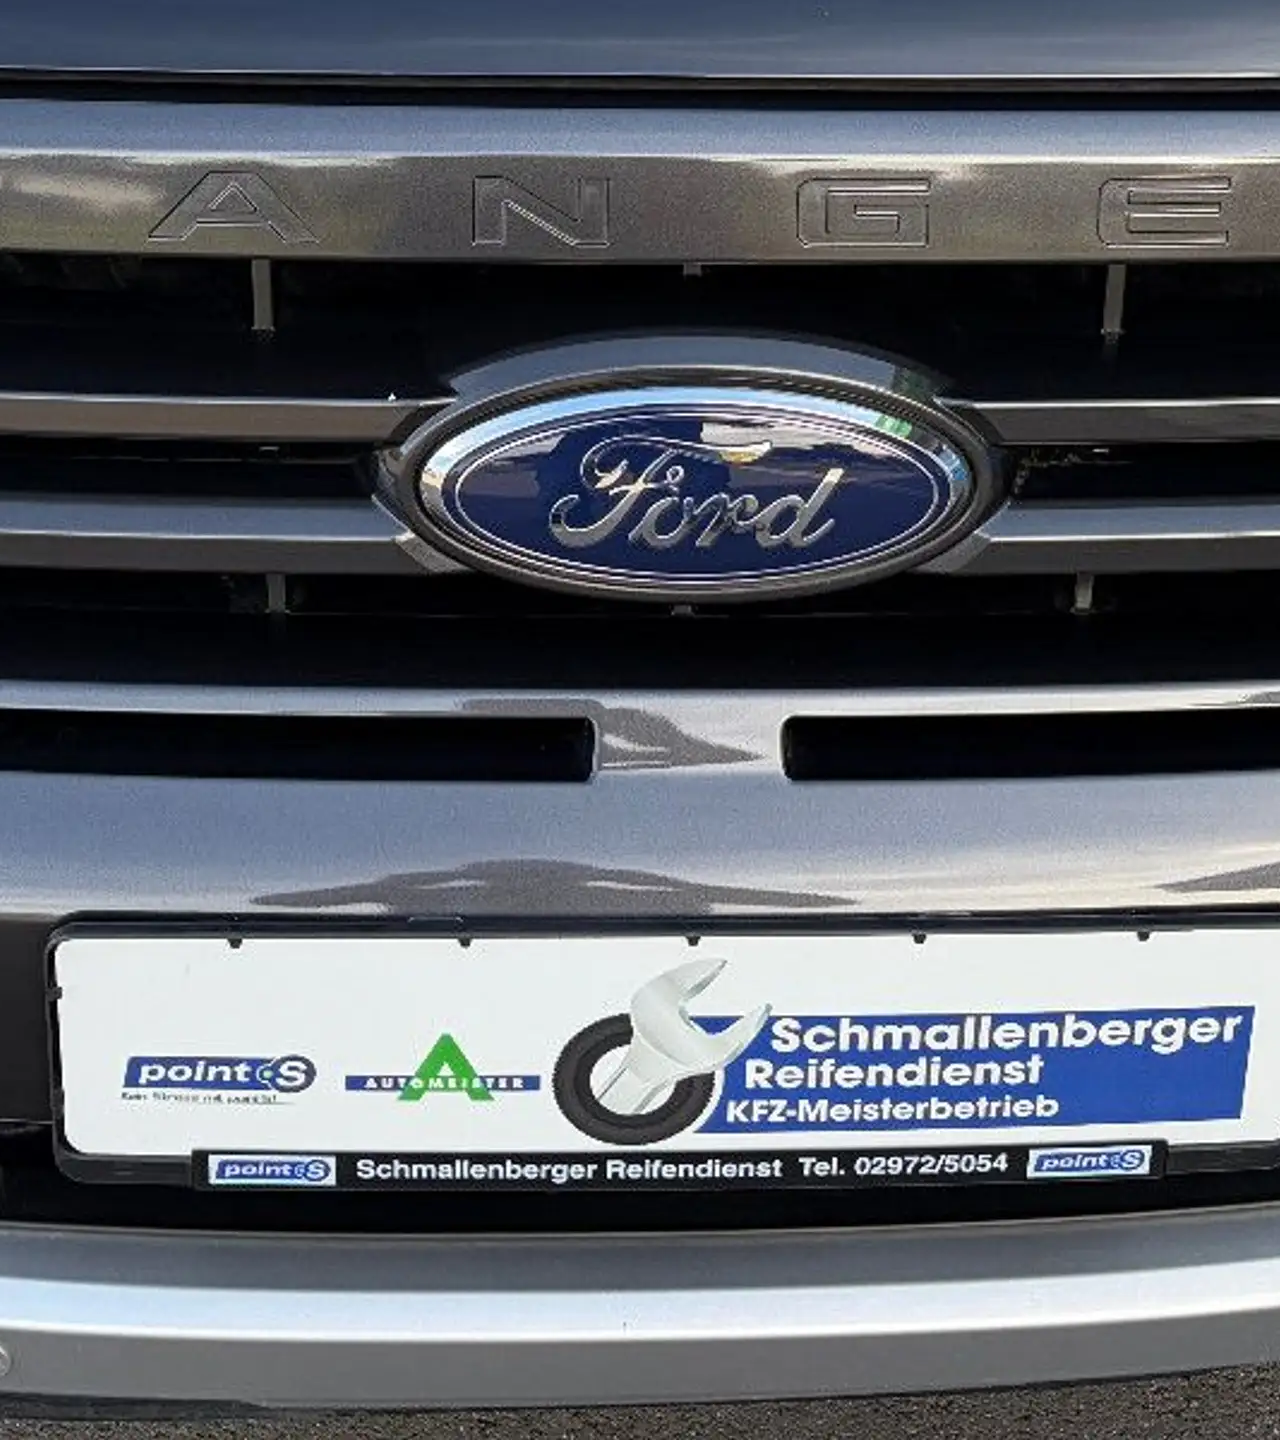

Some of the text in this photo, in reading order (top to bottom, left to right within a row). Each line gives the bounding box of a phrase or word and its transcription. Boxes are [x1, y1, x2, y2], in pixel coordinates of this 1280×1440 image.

[549, 434, 835, 549] Ford
[771, 1013, 1244, 1055] Schmallenberger
[363, 1076, 524, 1090] AUTOMEISTER
[744, 1053, 1045, 1089] Reifendienst
[725, 1093, 1060, 1123] KFZ-Meisterbetrieb
[355, 1152, 1008, 1184] Schmallenberger Reifendienst Tel. 02972/5054
